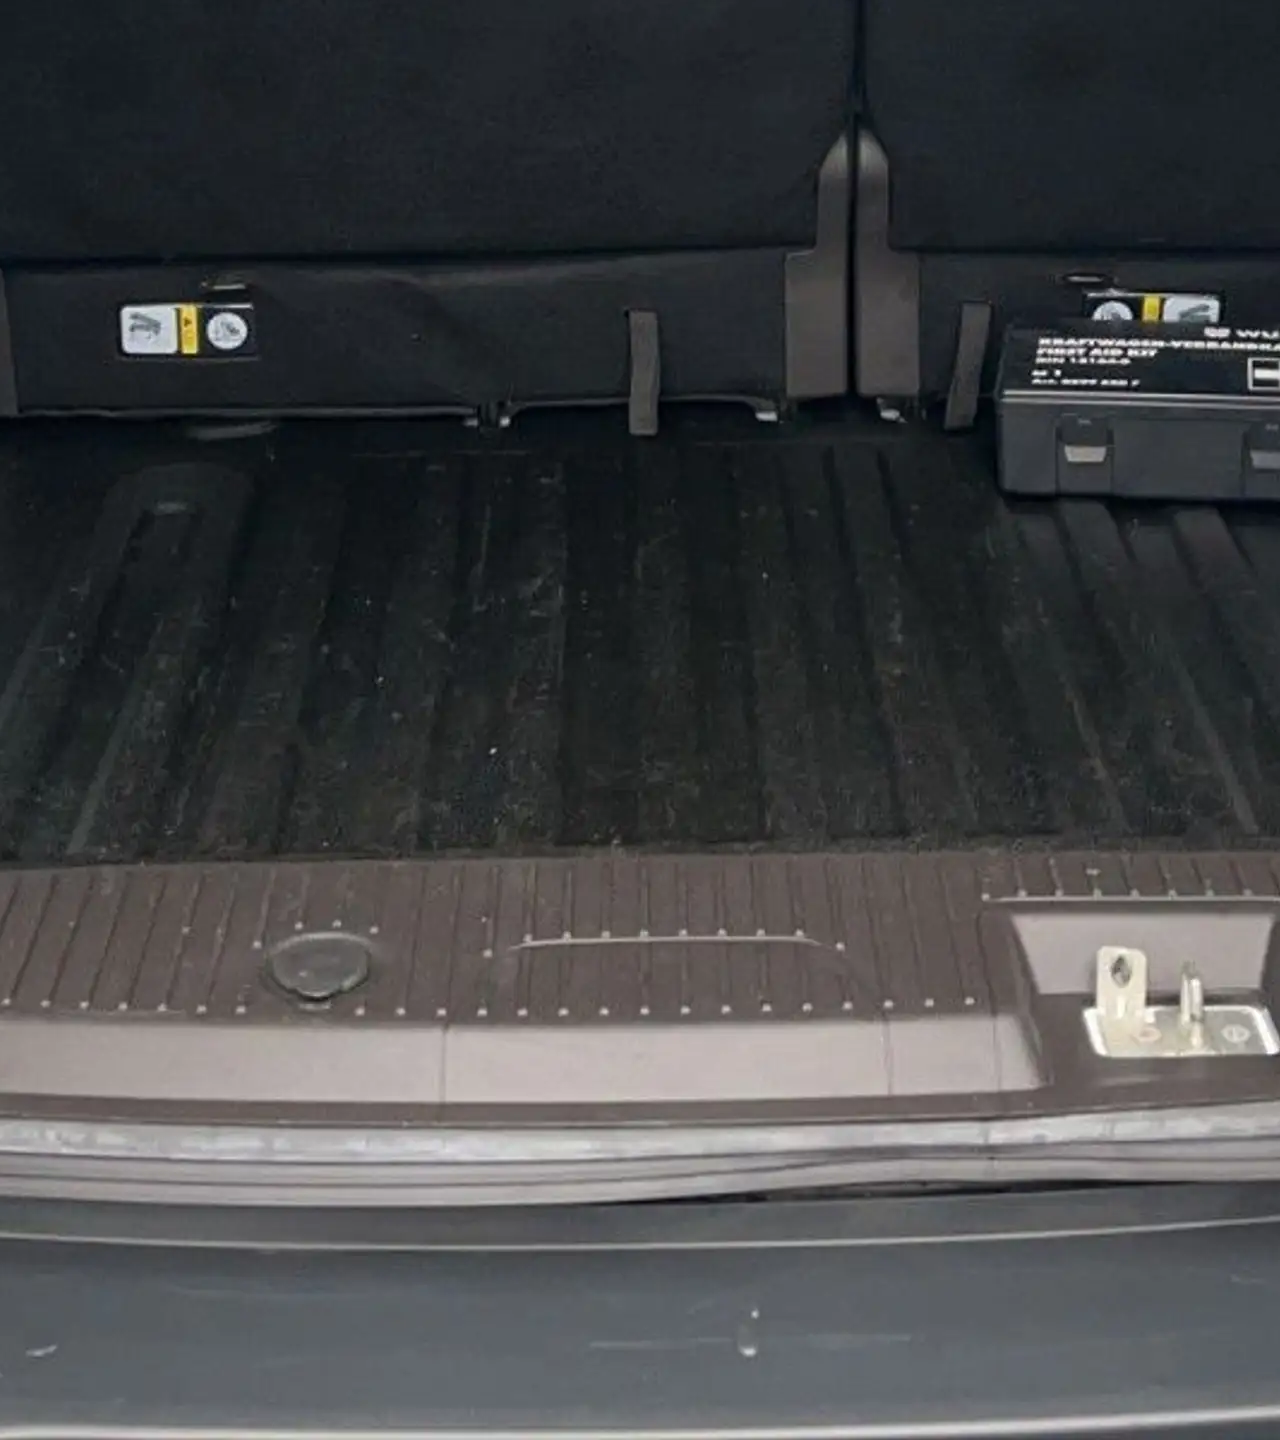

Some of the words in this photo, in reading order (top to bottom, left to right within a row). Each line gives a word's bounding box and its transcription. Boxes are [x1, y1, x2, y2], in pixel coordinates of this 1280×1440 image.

[1036, 347, 1087, 356] FIRST
[1088, 347, 1124, 356] AID
[1126, 348, 1158, 358] KIT
